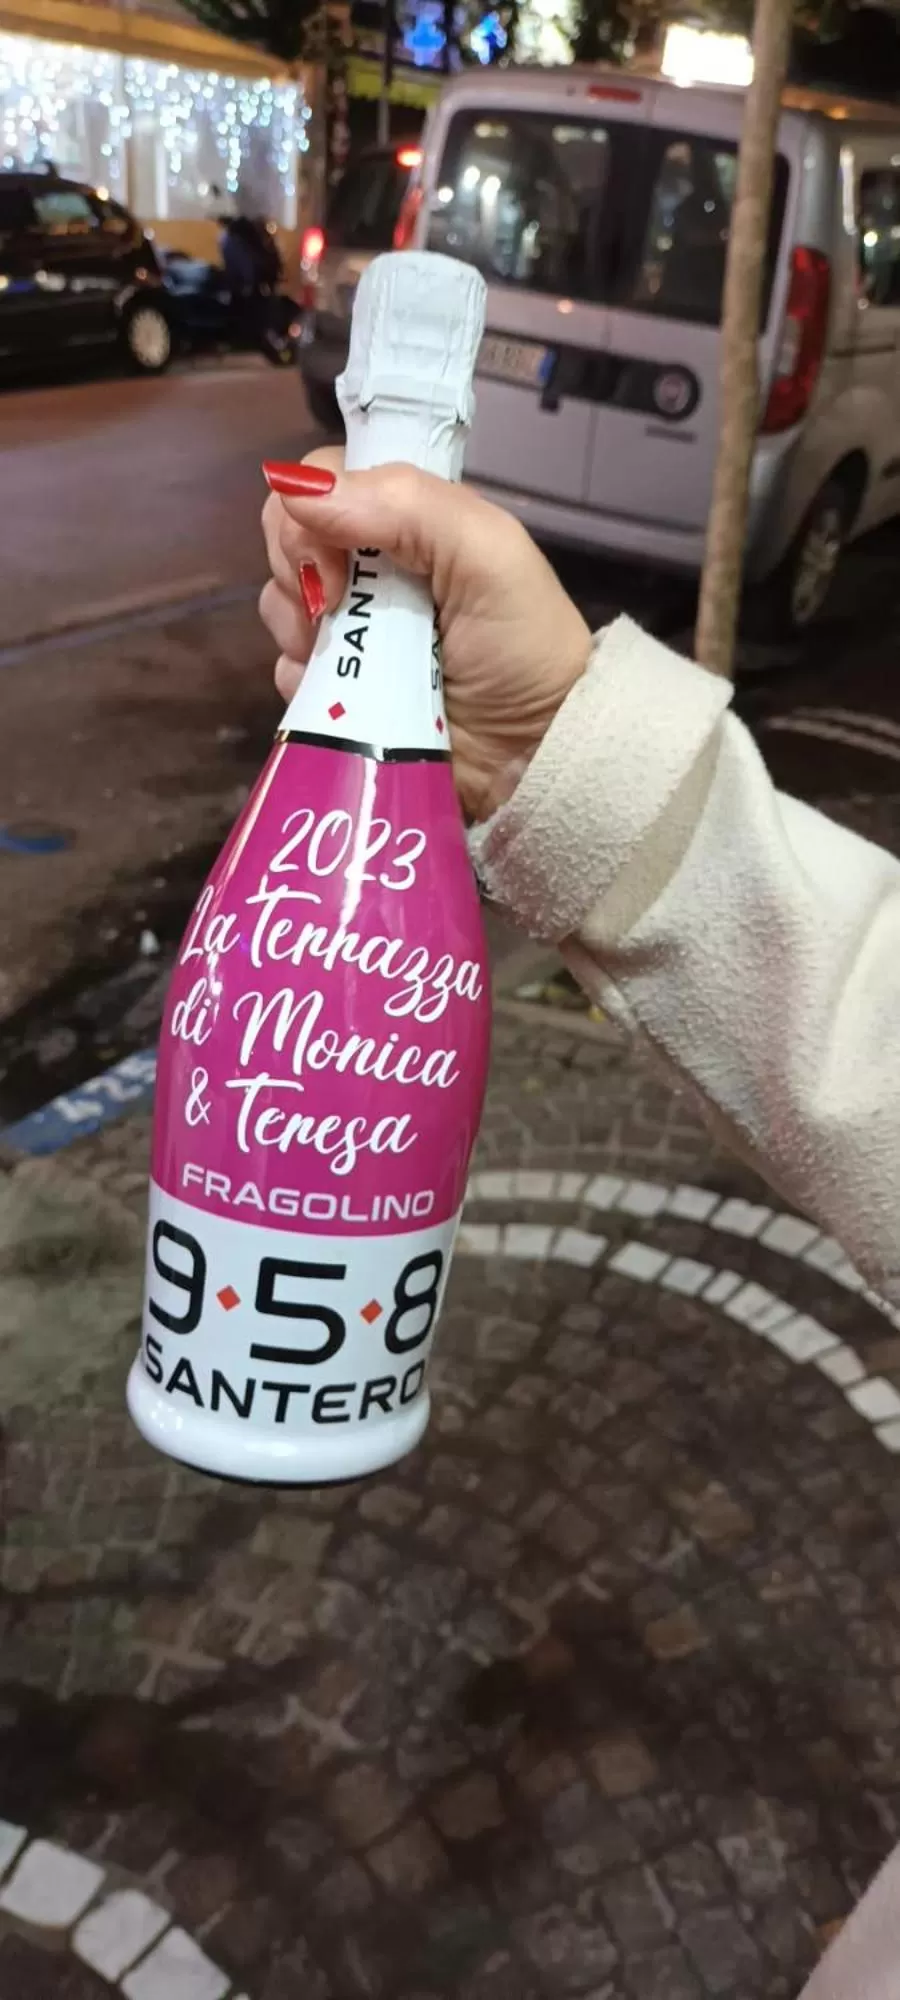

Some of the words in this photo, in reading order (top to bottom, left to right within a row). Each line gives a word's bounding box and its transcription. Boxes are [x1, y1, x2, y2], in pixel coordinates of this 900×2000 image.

[268, 808, 427, 890] 2023
[180, 885, 240, 966] La
[245, 874, 483, 1023] Terrazza
[171, 978, 218, 1046] di
[232, 987, 461, 1089] Monica
[184, 1066, 211, 1127] &
[224, 1070, 419, 1175] Teresa
[182, 1162, 435, 1222] FRAGOLINO
[144, 1333, 426, 1425] SANTERO
